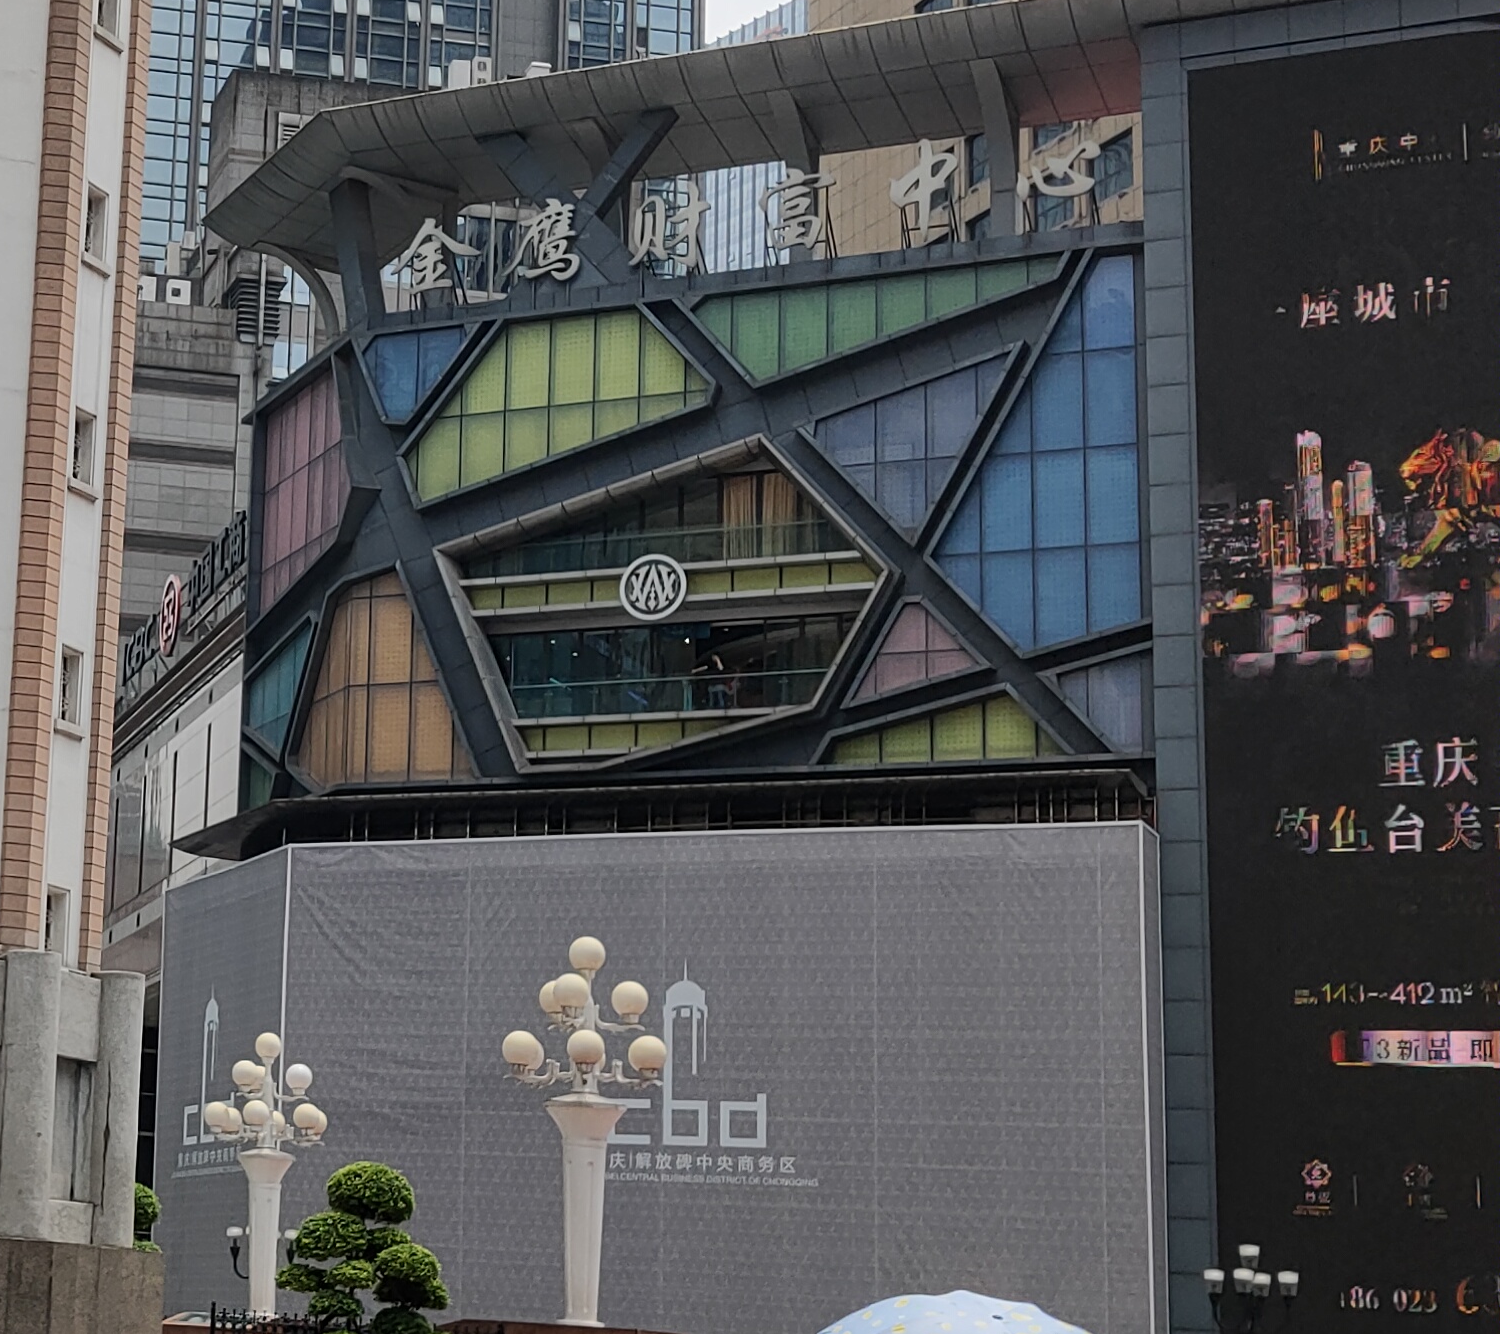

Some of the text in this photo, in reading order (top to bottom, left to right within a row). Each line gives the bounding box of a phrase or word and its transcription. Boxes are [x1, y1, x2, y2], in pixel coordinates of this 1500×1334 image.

[391, 138, 1102, 295] 金鹰财富中心
[1378, 737, 1478, 787] 重庆
[1274, 801, 1500, 854] 钓鱼台美
